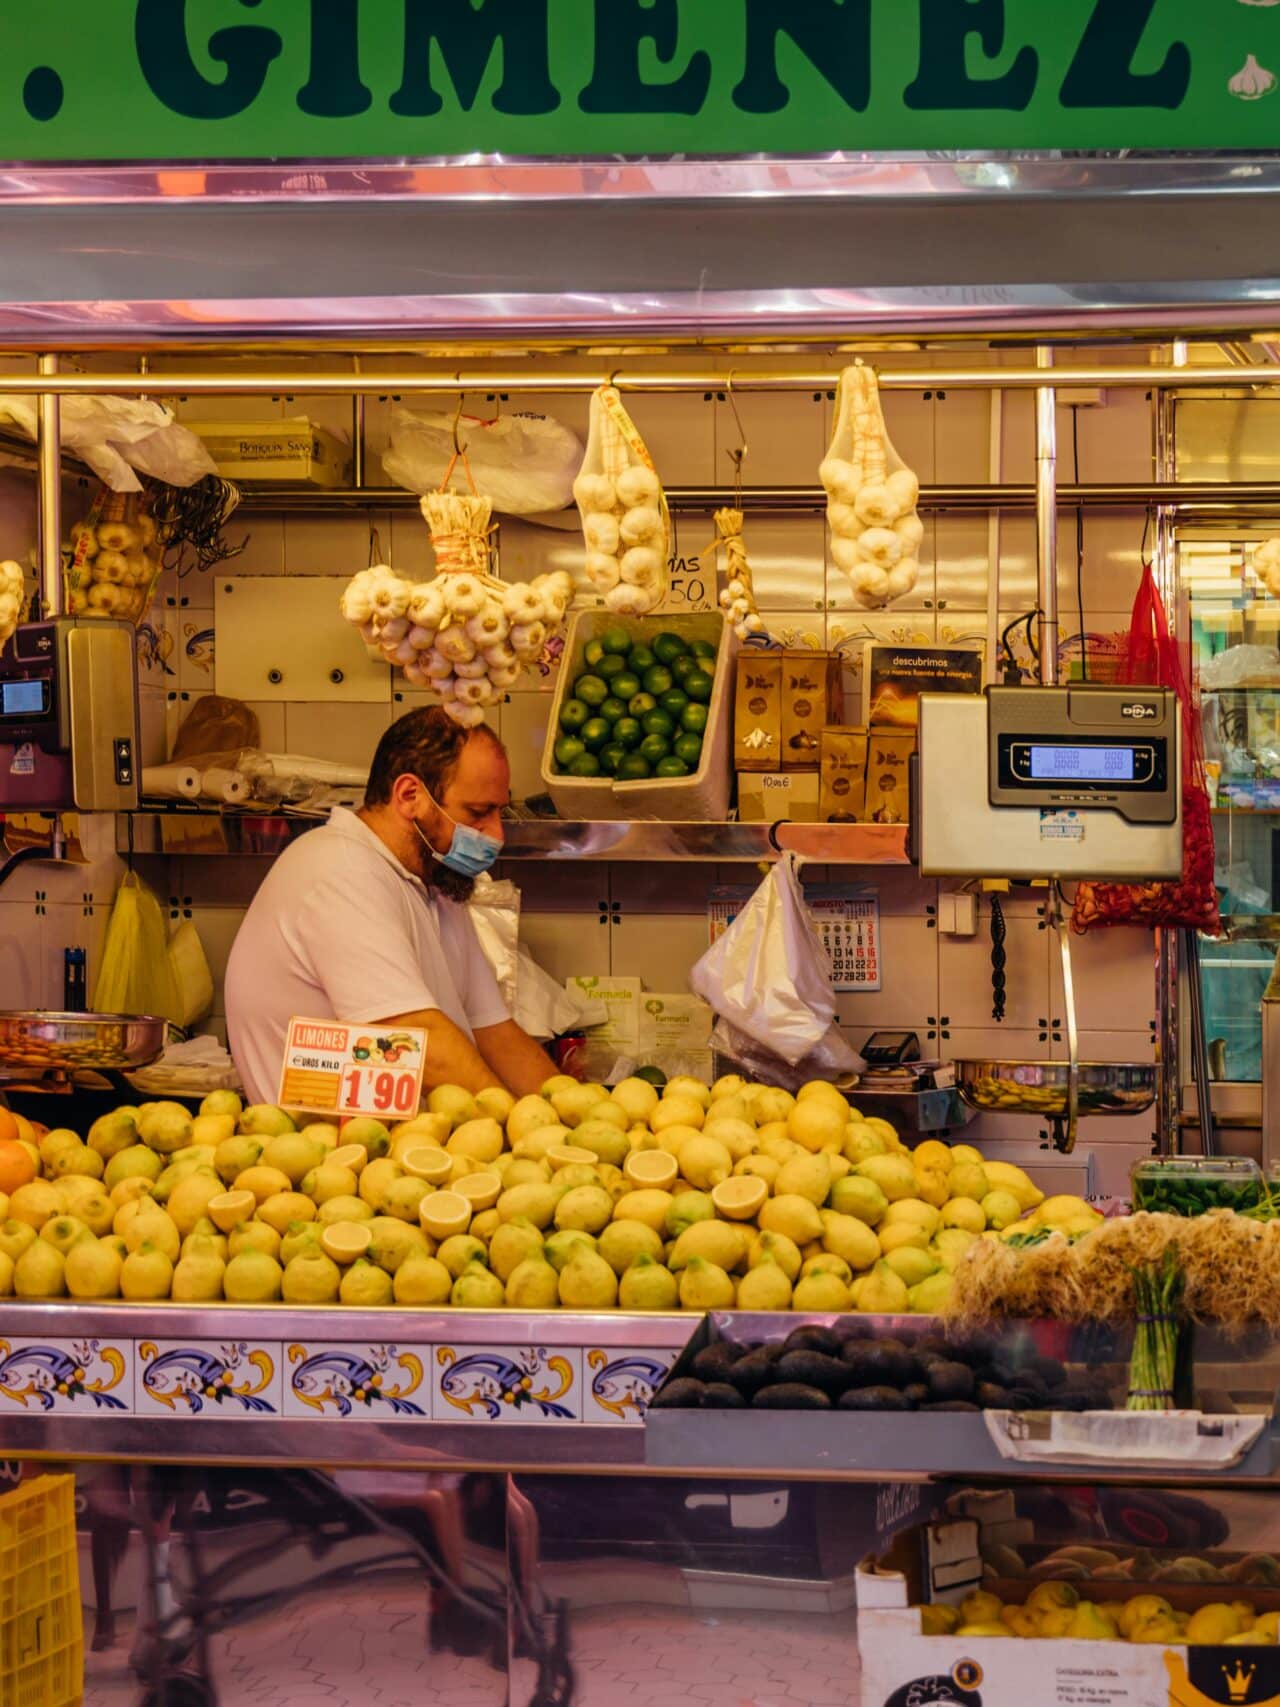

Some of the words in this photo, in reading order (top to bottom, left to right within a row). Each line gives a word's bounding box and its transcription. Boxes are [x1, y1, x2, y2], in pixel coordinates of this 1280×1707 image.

[135, 0, 1191, 120] GIMENEZ
[893, 656, 948, 667] descubrimos
[823, 936, 830, 946] 5
[835, 936, 841, 946] 6
[834, 948, 842, 957] 13
[845, 948, 853, 957] 14
[856, 947, 865, 957] 15
[867, 948, 876, 957] 16
[833, 960, 843, 969] 20
[845, 960, 854, 969] 21
[855, 960, 866, 969] 22
[867, 960, 877, 969] 23
[833, 971, 843, 981] 27
[844, 972, 855, 981] 28
[856, 971, 866, 981] 29
[867, 971, 877, 981] 30
[295, 1026, 347, 1049] LIMONES
[321, 1059, 340, 1070] KILO
